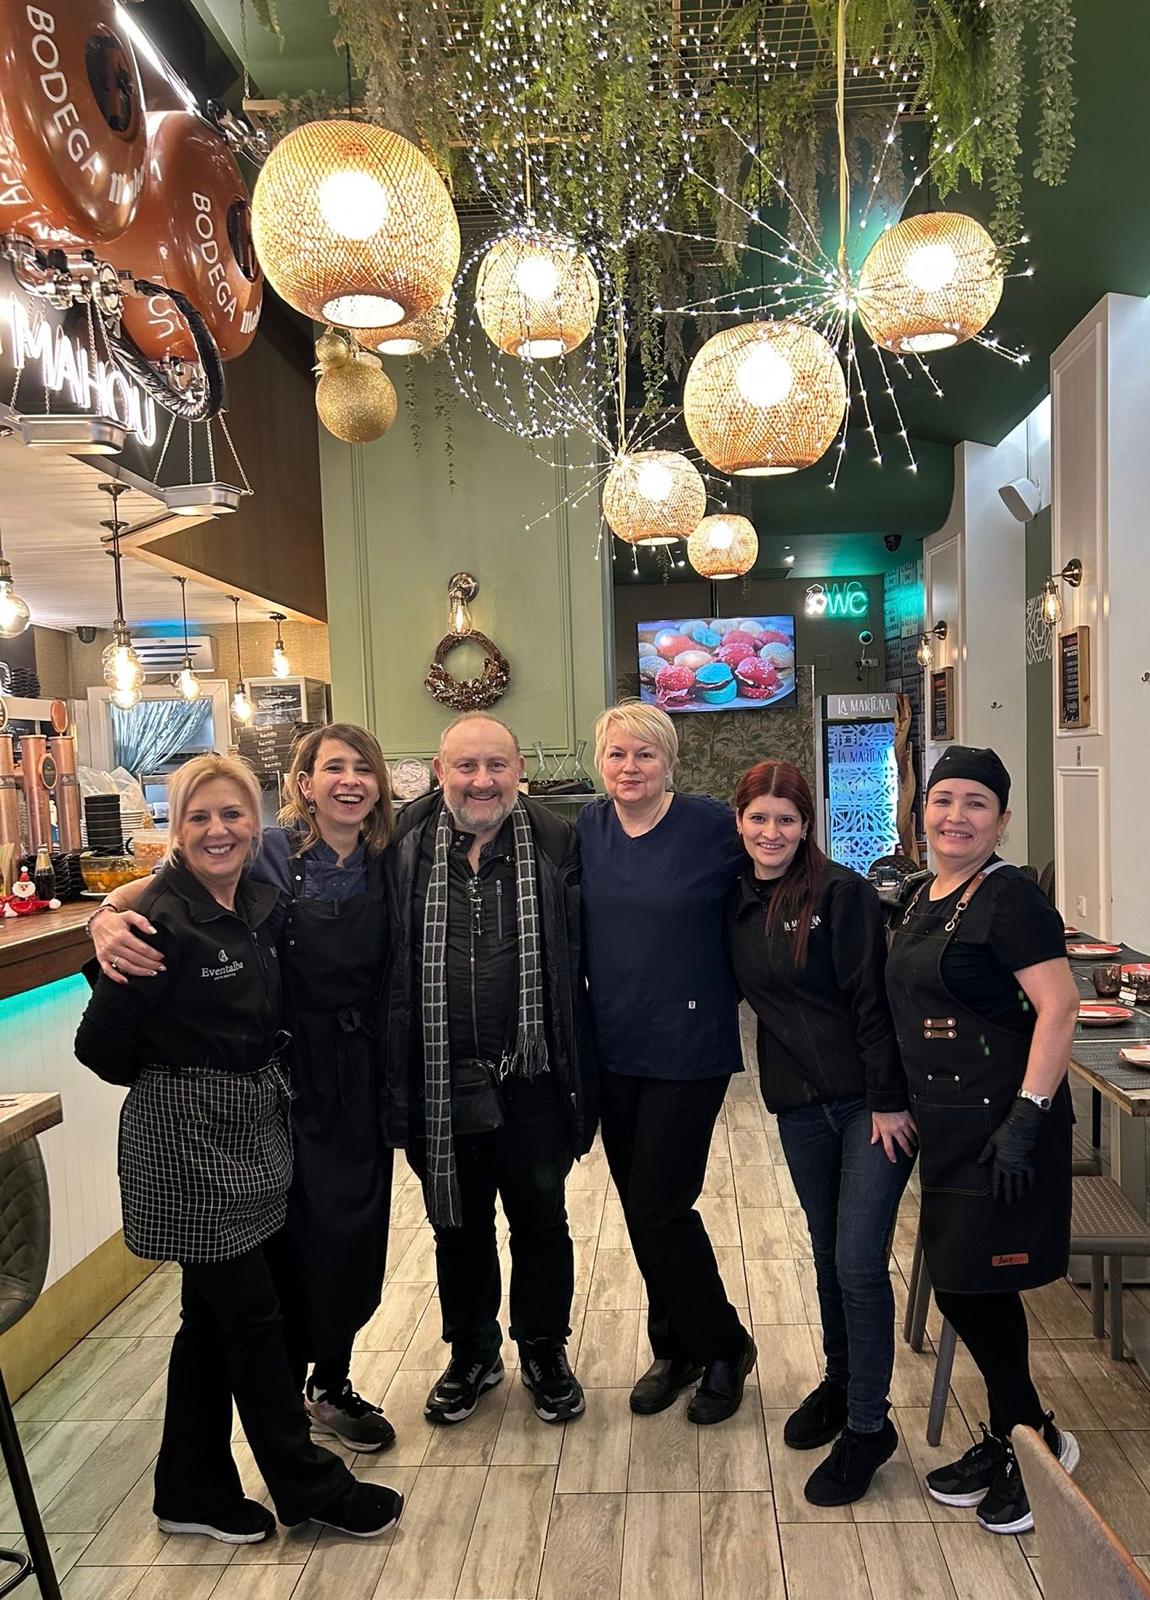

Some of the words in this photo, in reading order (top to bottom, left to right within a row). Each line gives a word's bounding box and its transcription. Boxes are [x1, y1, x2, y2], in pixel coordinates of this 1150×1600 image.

[26, 4, 99, 185] BODEGA
[192, 191, 237, 323] BODEGA
[9, 291, 157, 447] MAHOU
[825, 585, 868, 614] WC
[837, 697, 849, 716] LA
